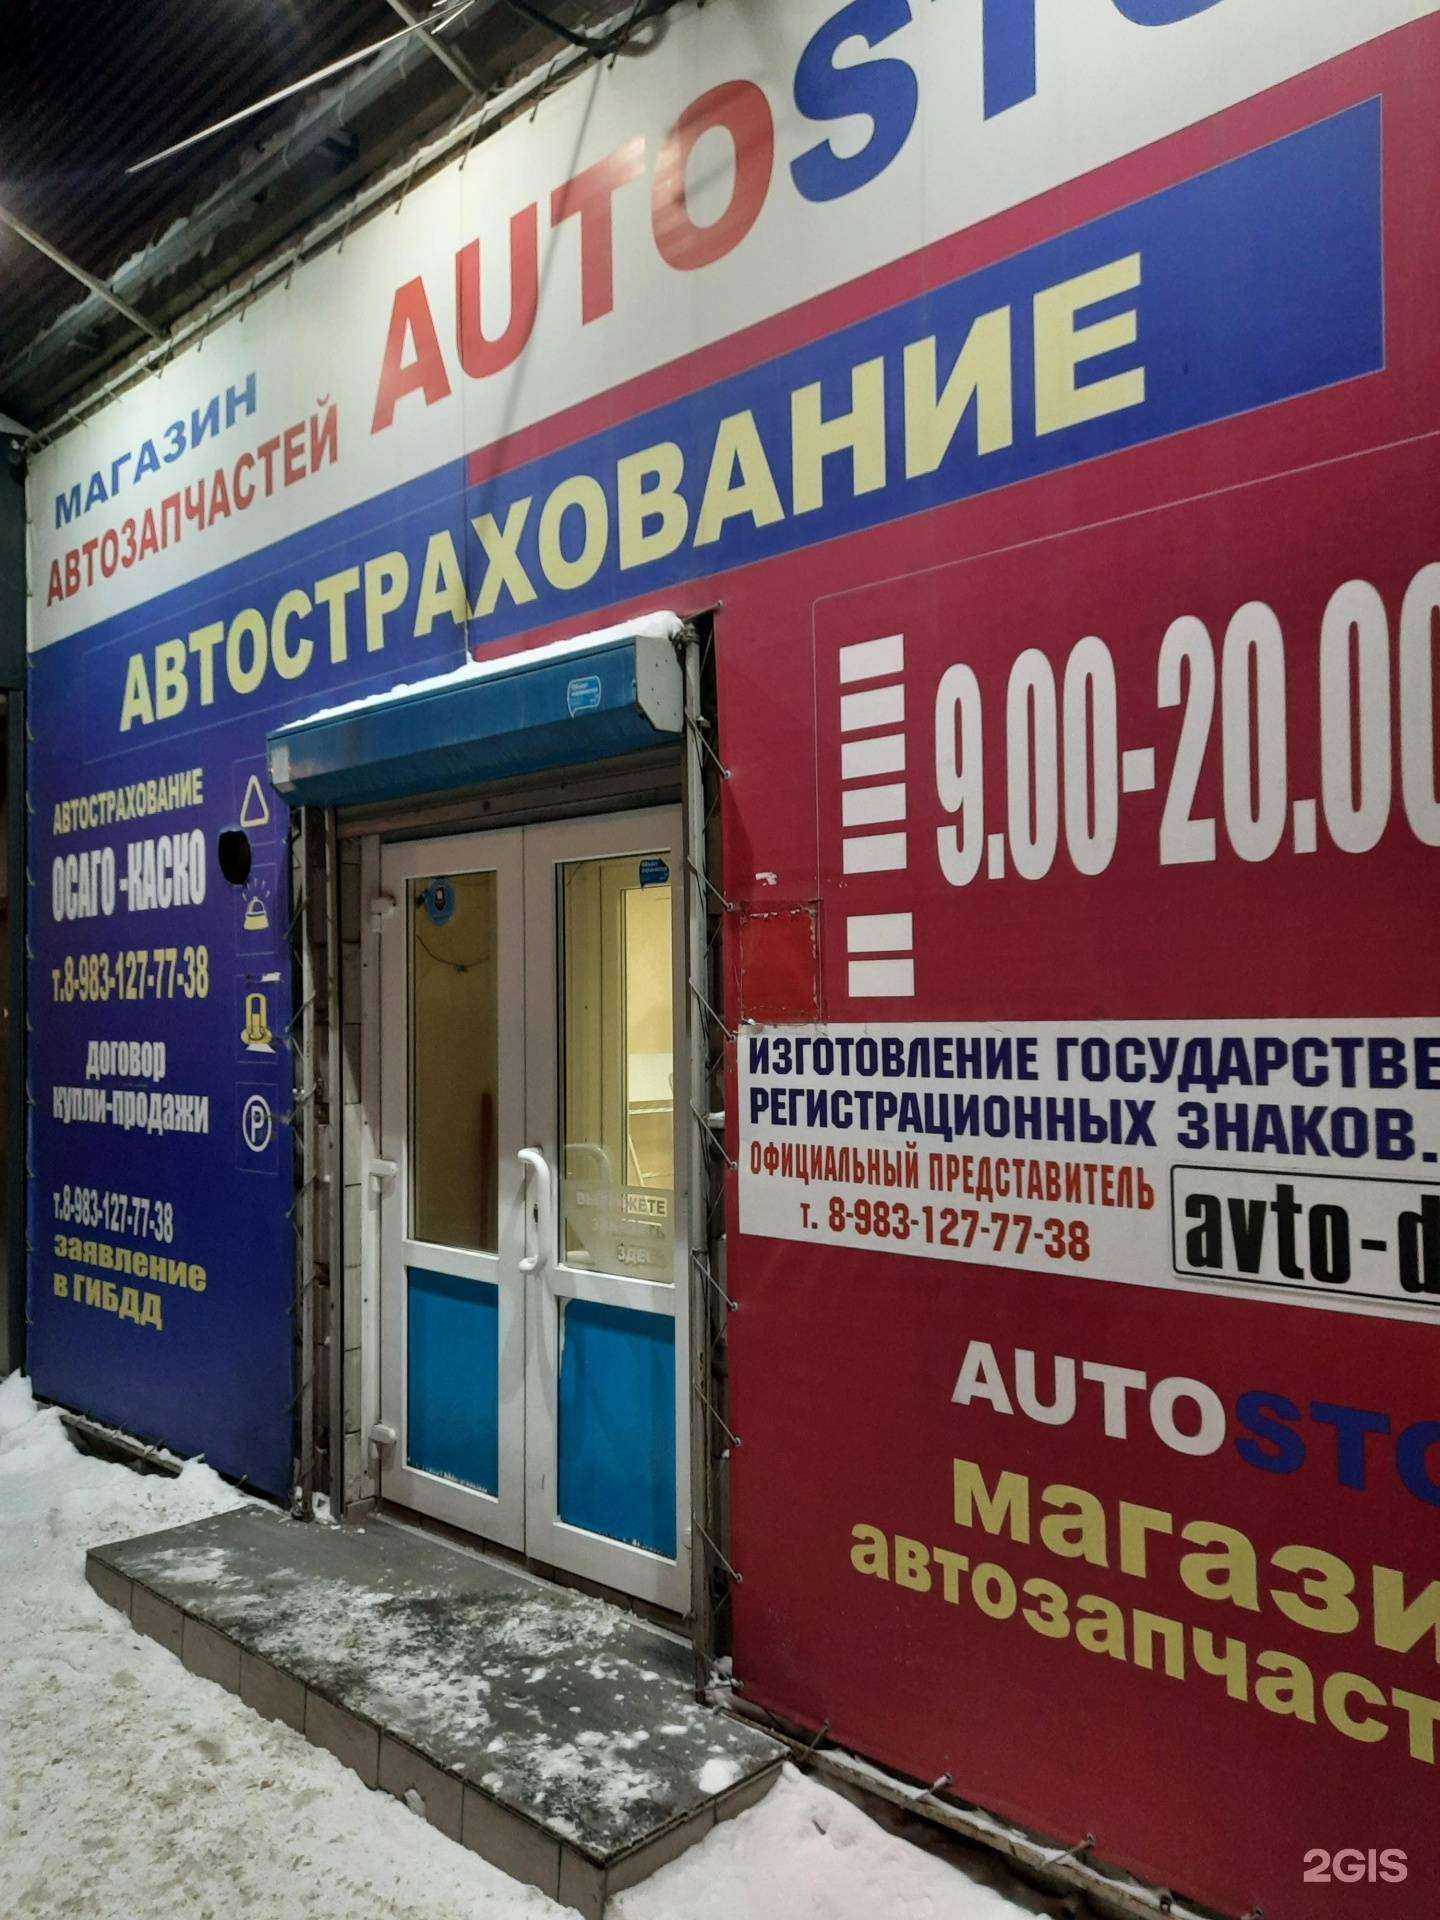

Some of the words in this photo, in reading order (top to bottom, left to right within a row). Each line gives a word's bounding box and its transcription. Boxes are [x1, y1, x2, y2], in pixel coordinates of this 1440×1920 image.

[371, 0, 1227, 435] AUTOS
[55, 373, 257, 529] МАГАЗИН
[47, 394, 338, 607] АВТОЗАПЧАСТЕЙ
[119, 252, 1145, 731] АВТОСТРАХОВАНИЕ
[53, 768, 204, 835] АВТОСТРАХОВАНИЕ
[749, 1037, 1039, 1080] ИЗГОТОВЛЕНИЕ
[1056, 1037, 1440, 1093] ГОСУДАРСТВЕ
[52, 1086, 209, 1136] купли-продажи
[749, 1087, 1158, 1147] РЕГИСТРАЦИОННЫХ
[750, 1140, 919, 1189] ОФИЦИАЛЬНЫЙ
[929, 1153, 1155, 1210] ПРЕДСТАВИТЕЛЬ
[828, 1196, 1091, 1262] 8-983-127-77-38
[53, 1234, 207, 1293] заявление
[73, 1274, 164, 1331] ГИБДД
[850, 1523, 1440, 1764] автозапчаст
